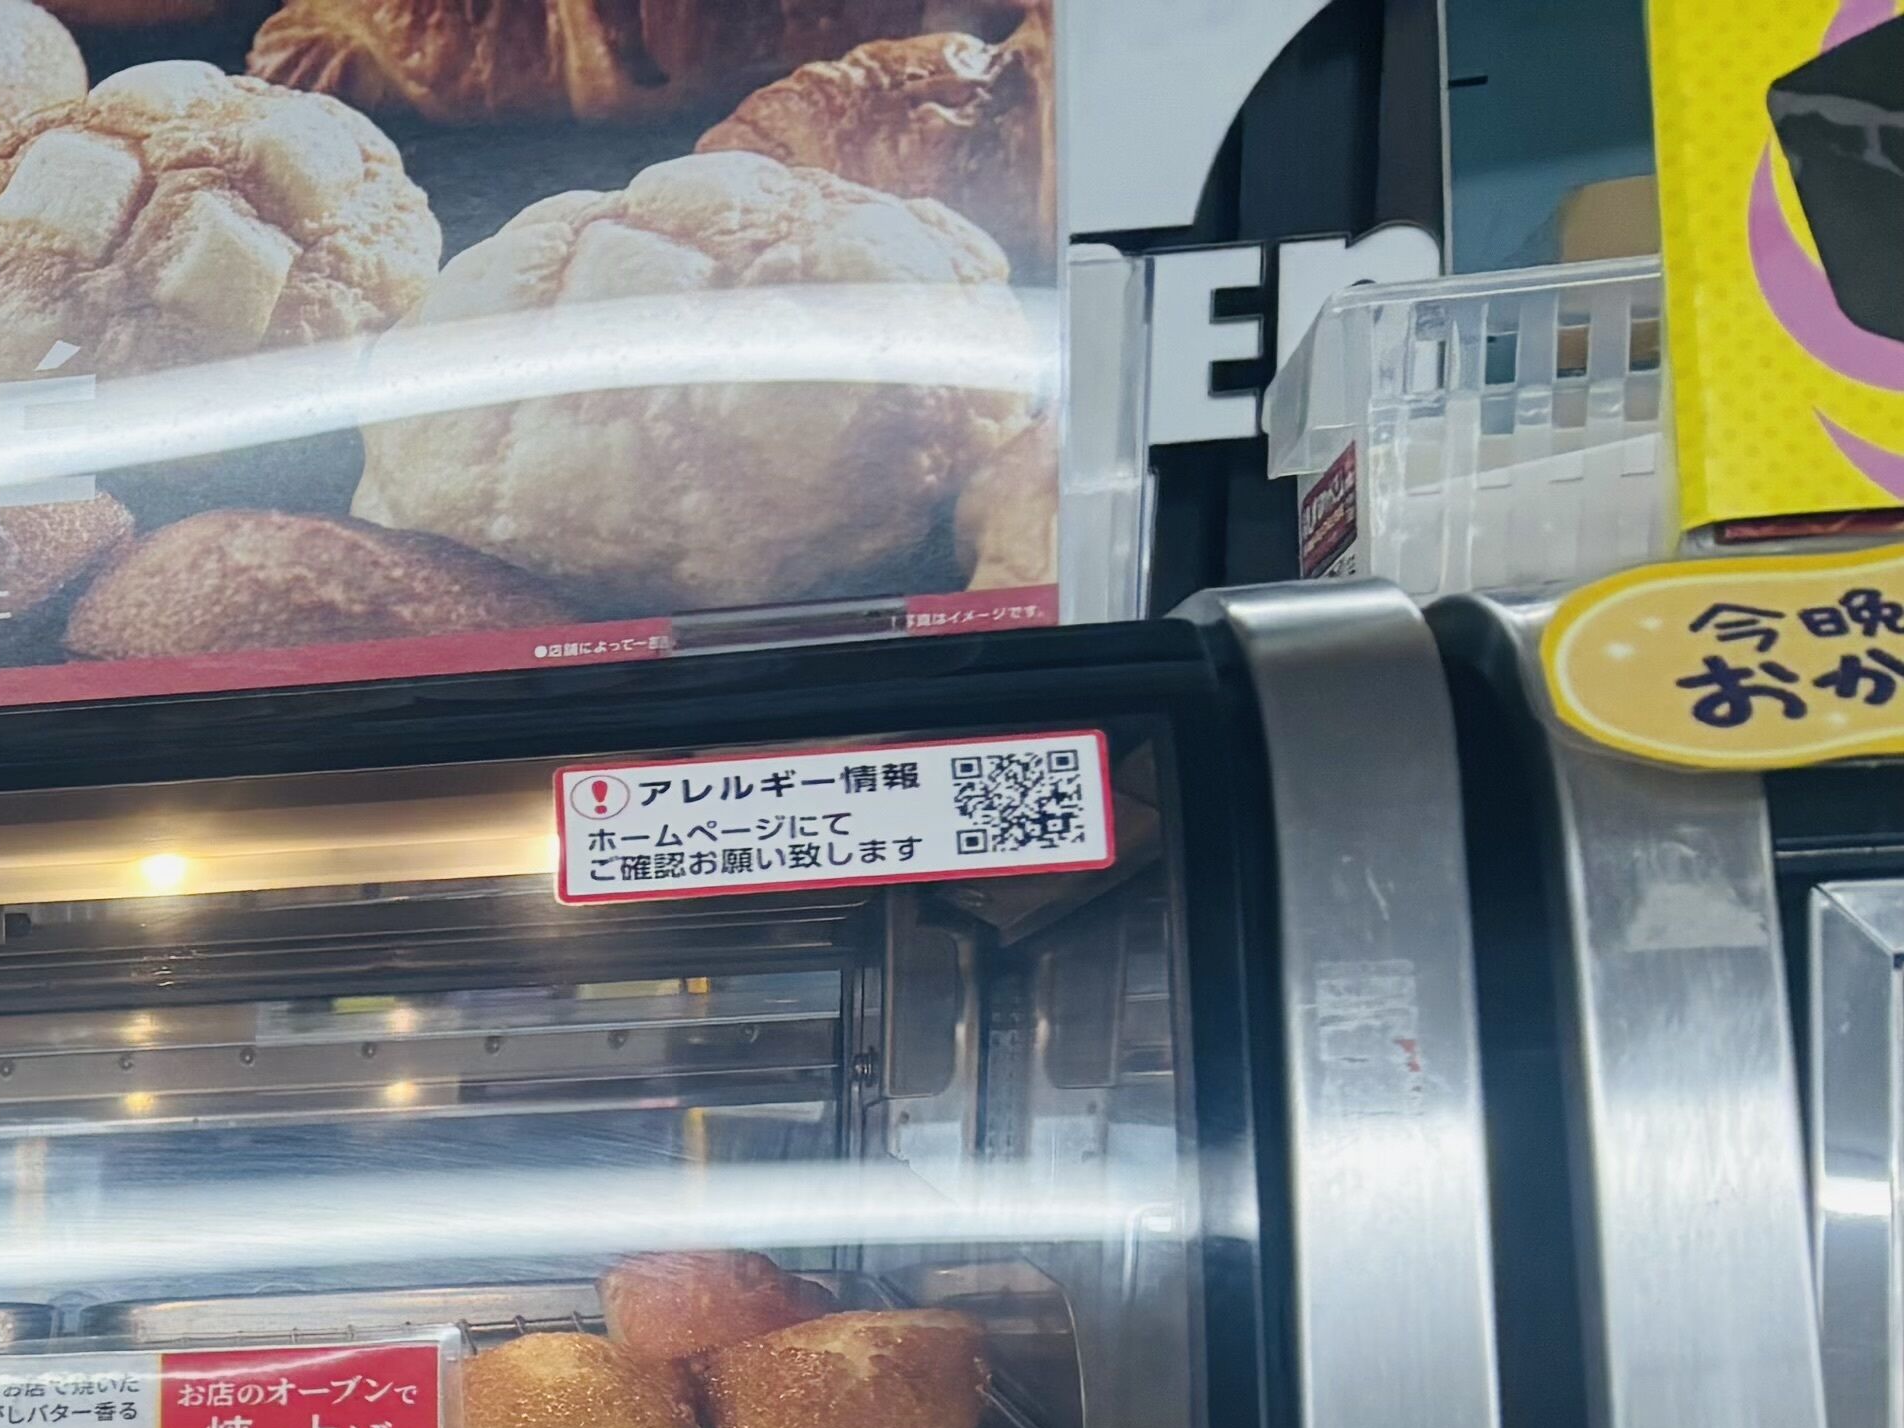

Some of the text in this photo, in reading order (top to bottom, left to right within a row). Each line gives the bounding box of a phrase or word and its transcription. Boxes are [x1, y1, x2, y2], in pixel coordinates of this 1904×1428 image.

[638, 762, 921, 808] アレルギー情報
[587, 812, 853, 854] ホームページにて
[589, 836, 924, 882] ご確認お願い致します
[178, 1374, 418, 1407] お店のオーブンで
